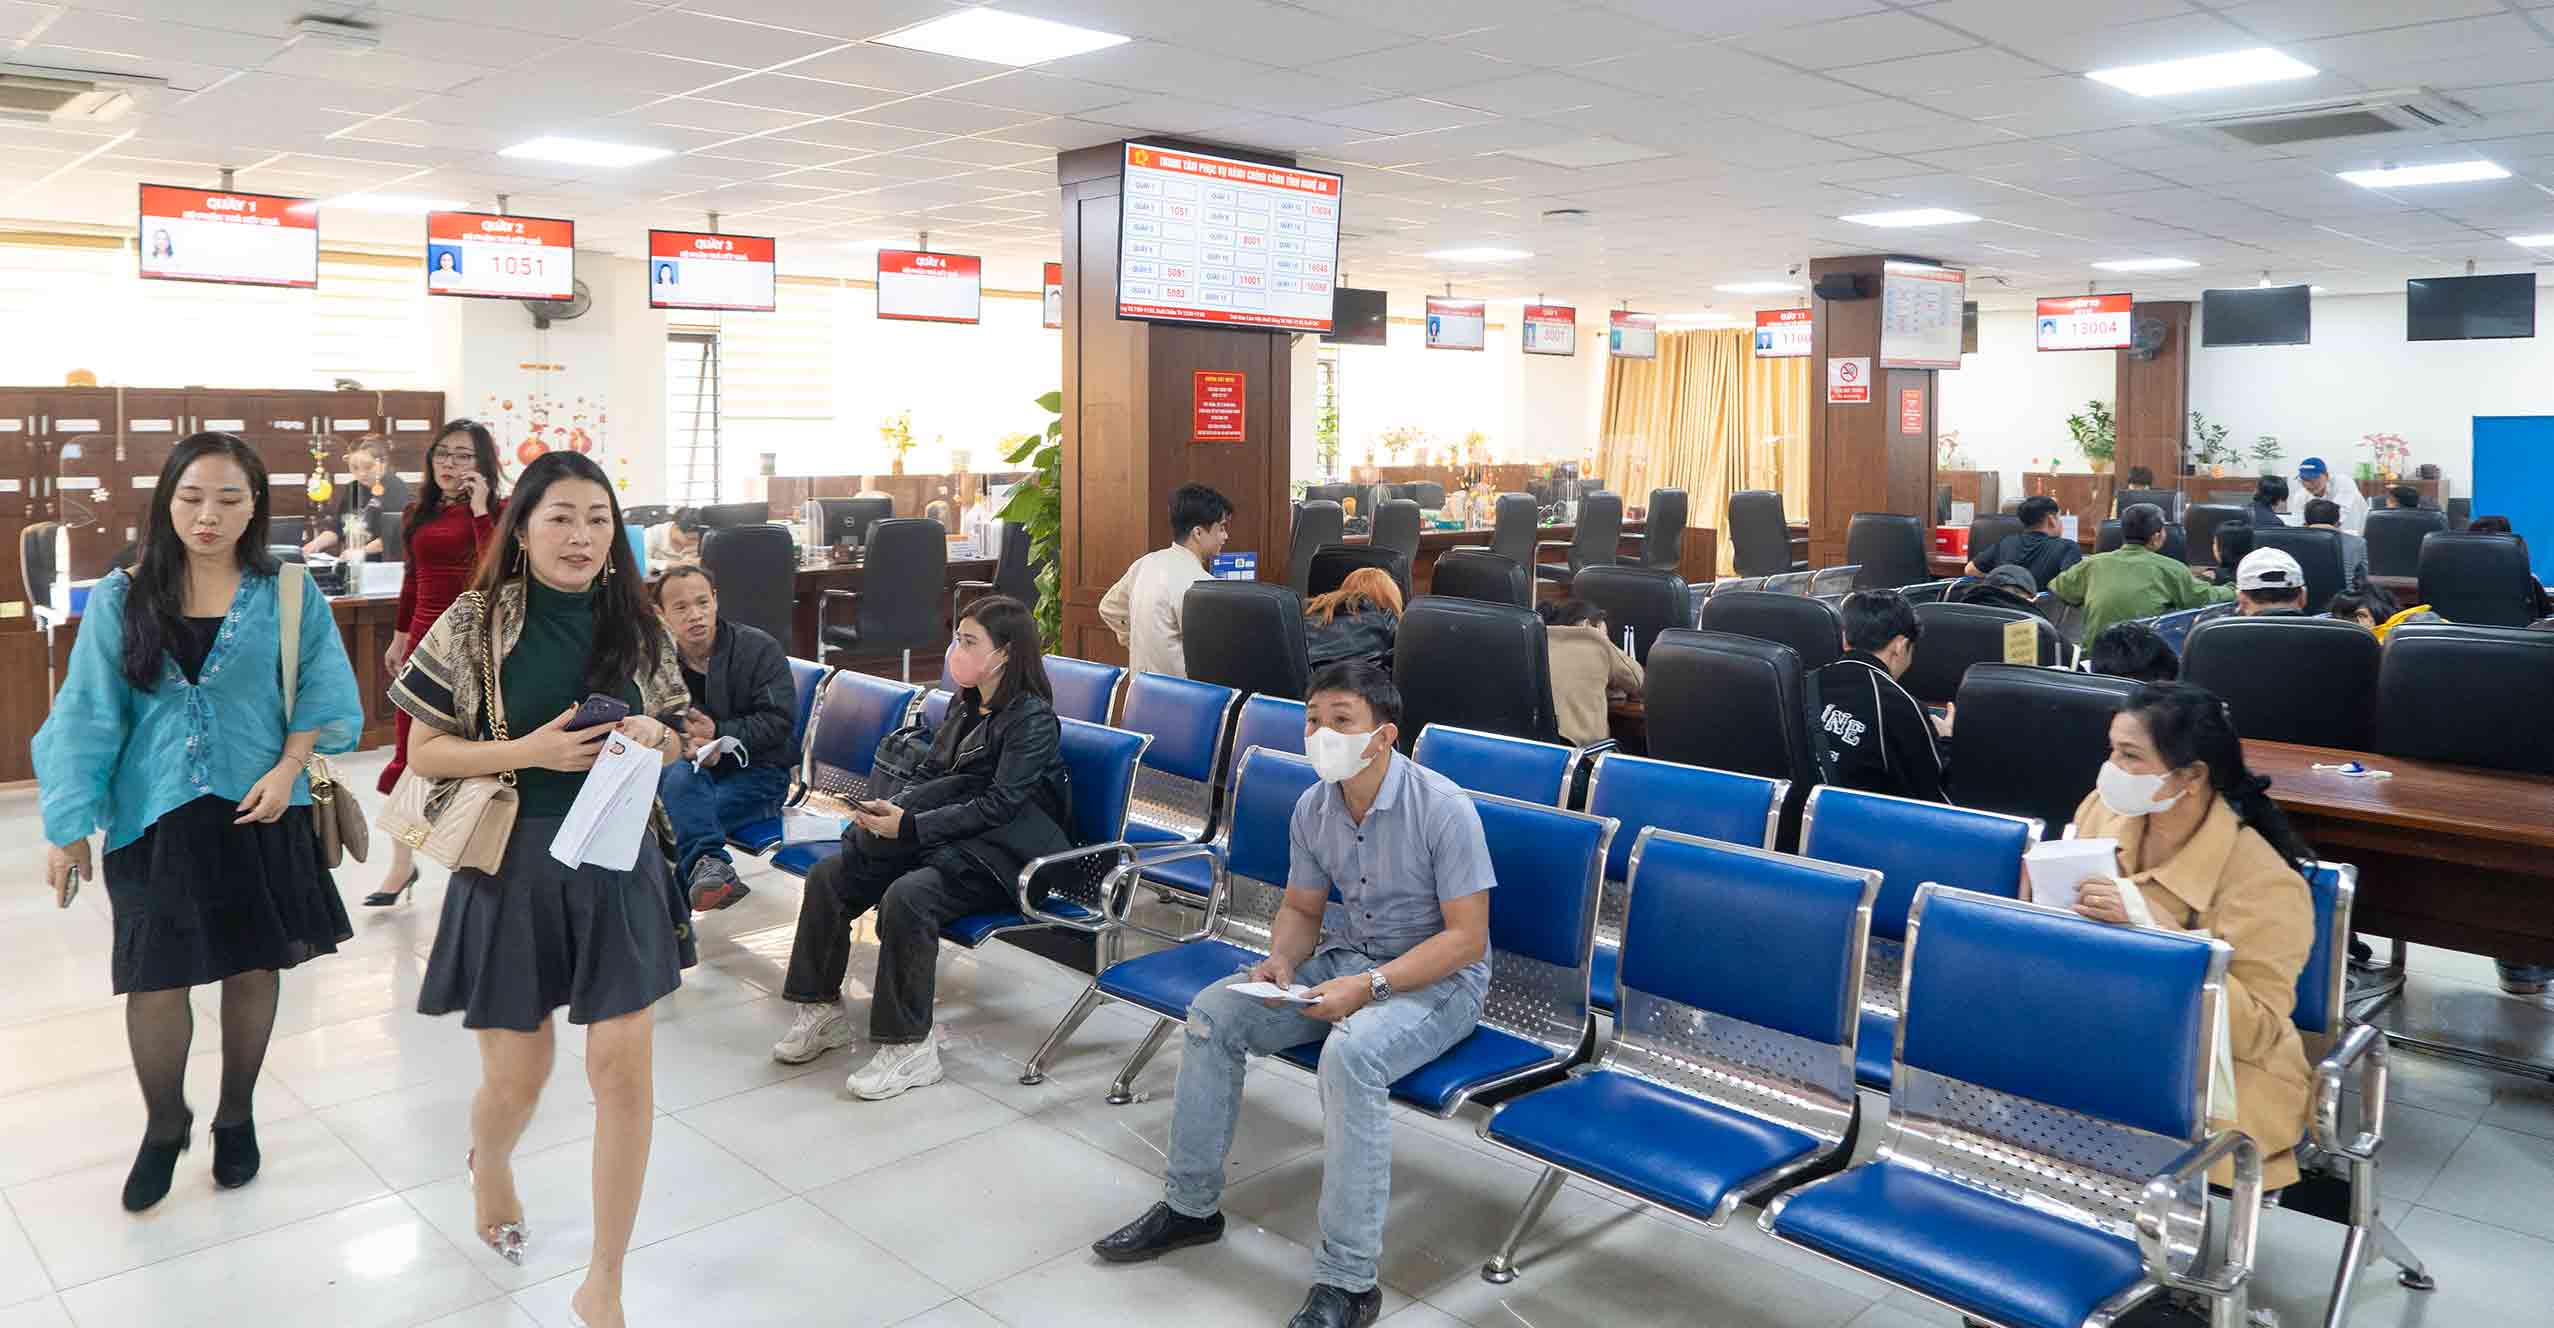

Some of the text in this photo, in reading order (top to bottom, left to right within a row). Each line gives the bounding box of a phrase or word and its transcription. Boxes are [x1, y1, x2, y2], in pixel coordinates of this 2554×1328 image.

[207, 196, 256, 212] QUẦY 1
[481, 219, 524, 233] QUẦY 2
[725, 240, 733, 250] 3
[493, 256, 544, 277] 1051
[940, 258, 947, 268] 4
[2072, 320, 2117, 337] 13004
